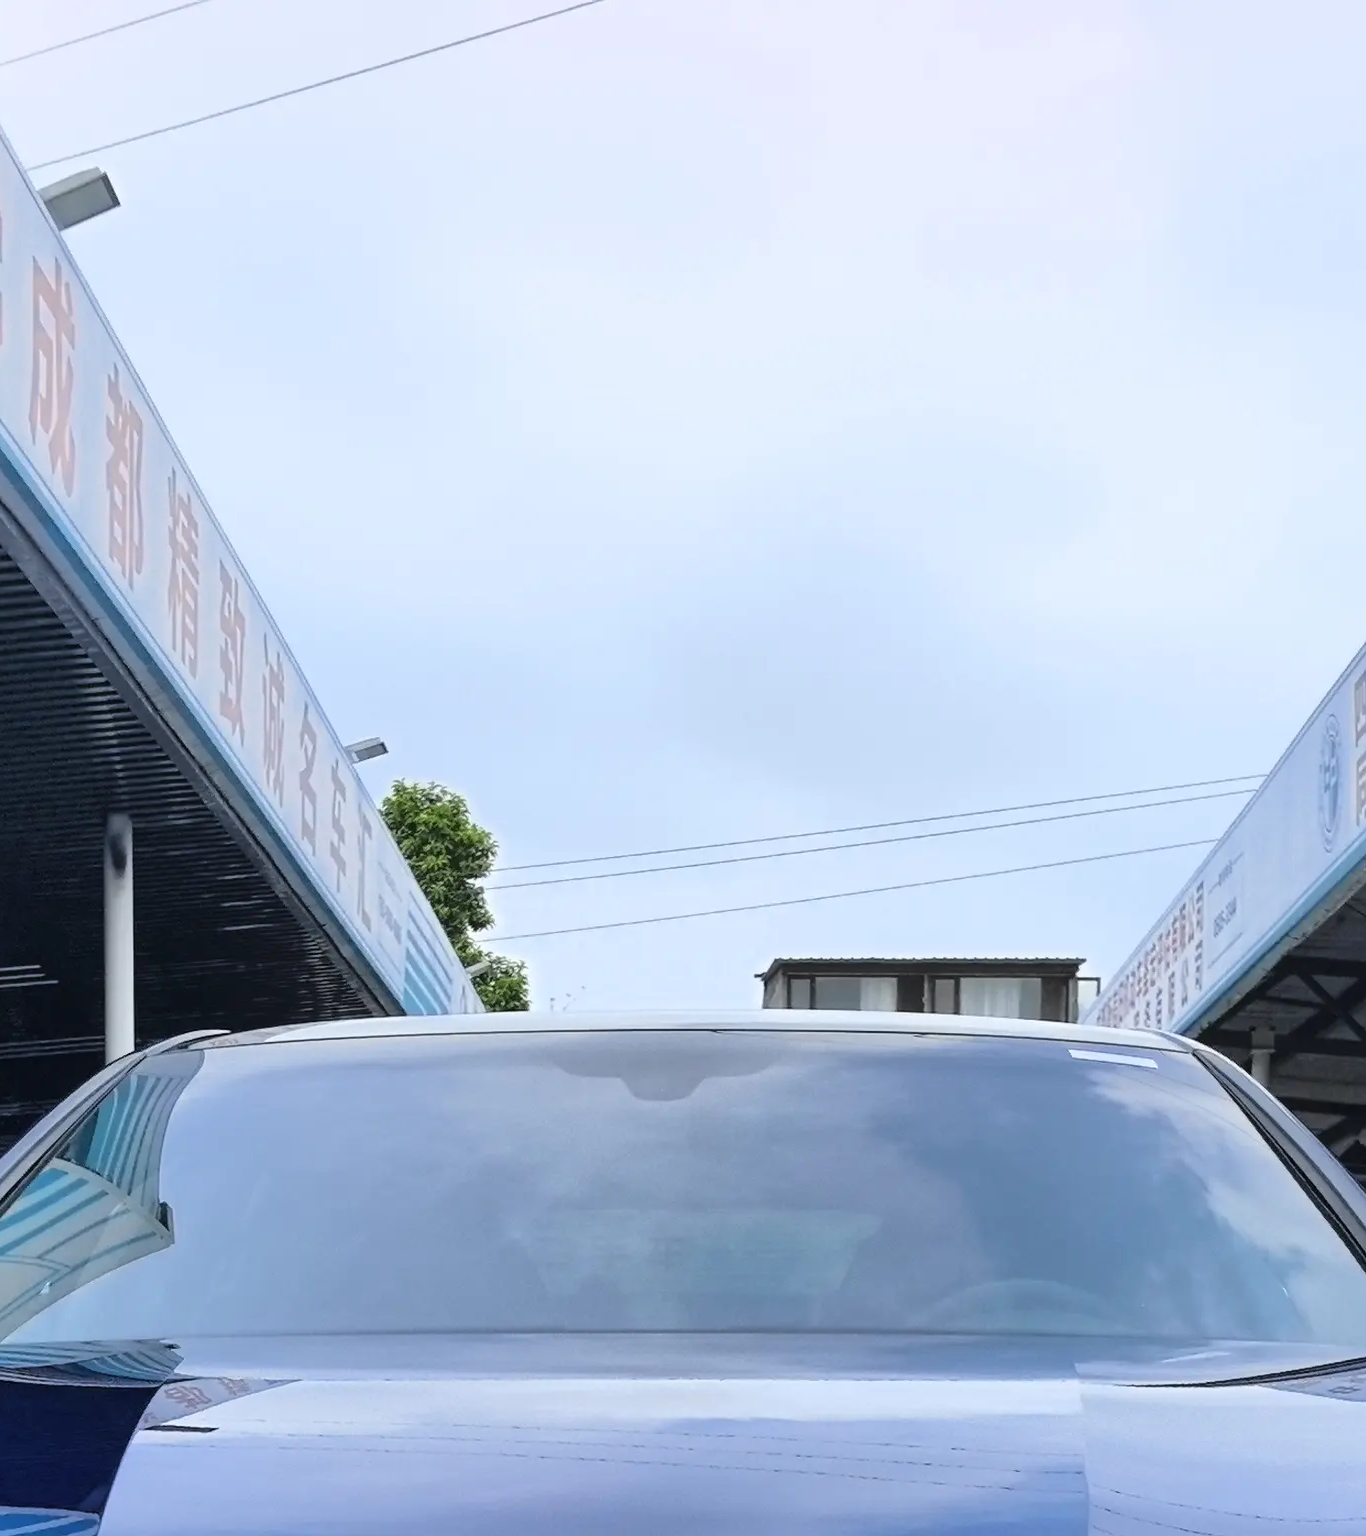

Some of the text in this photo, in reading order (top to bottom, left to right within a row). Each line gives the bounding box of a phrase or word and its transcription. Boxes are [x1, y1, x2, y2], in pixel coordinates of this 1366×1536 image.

[28, 254, 375, 934] 成都精致诚名车汇
